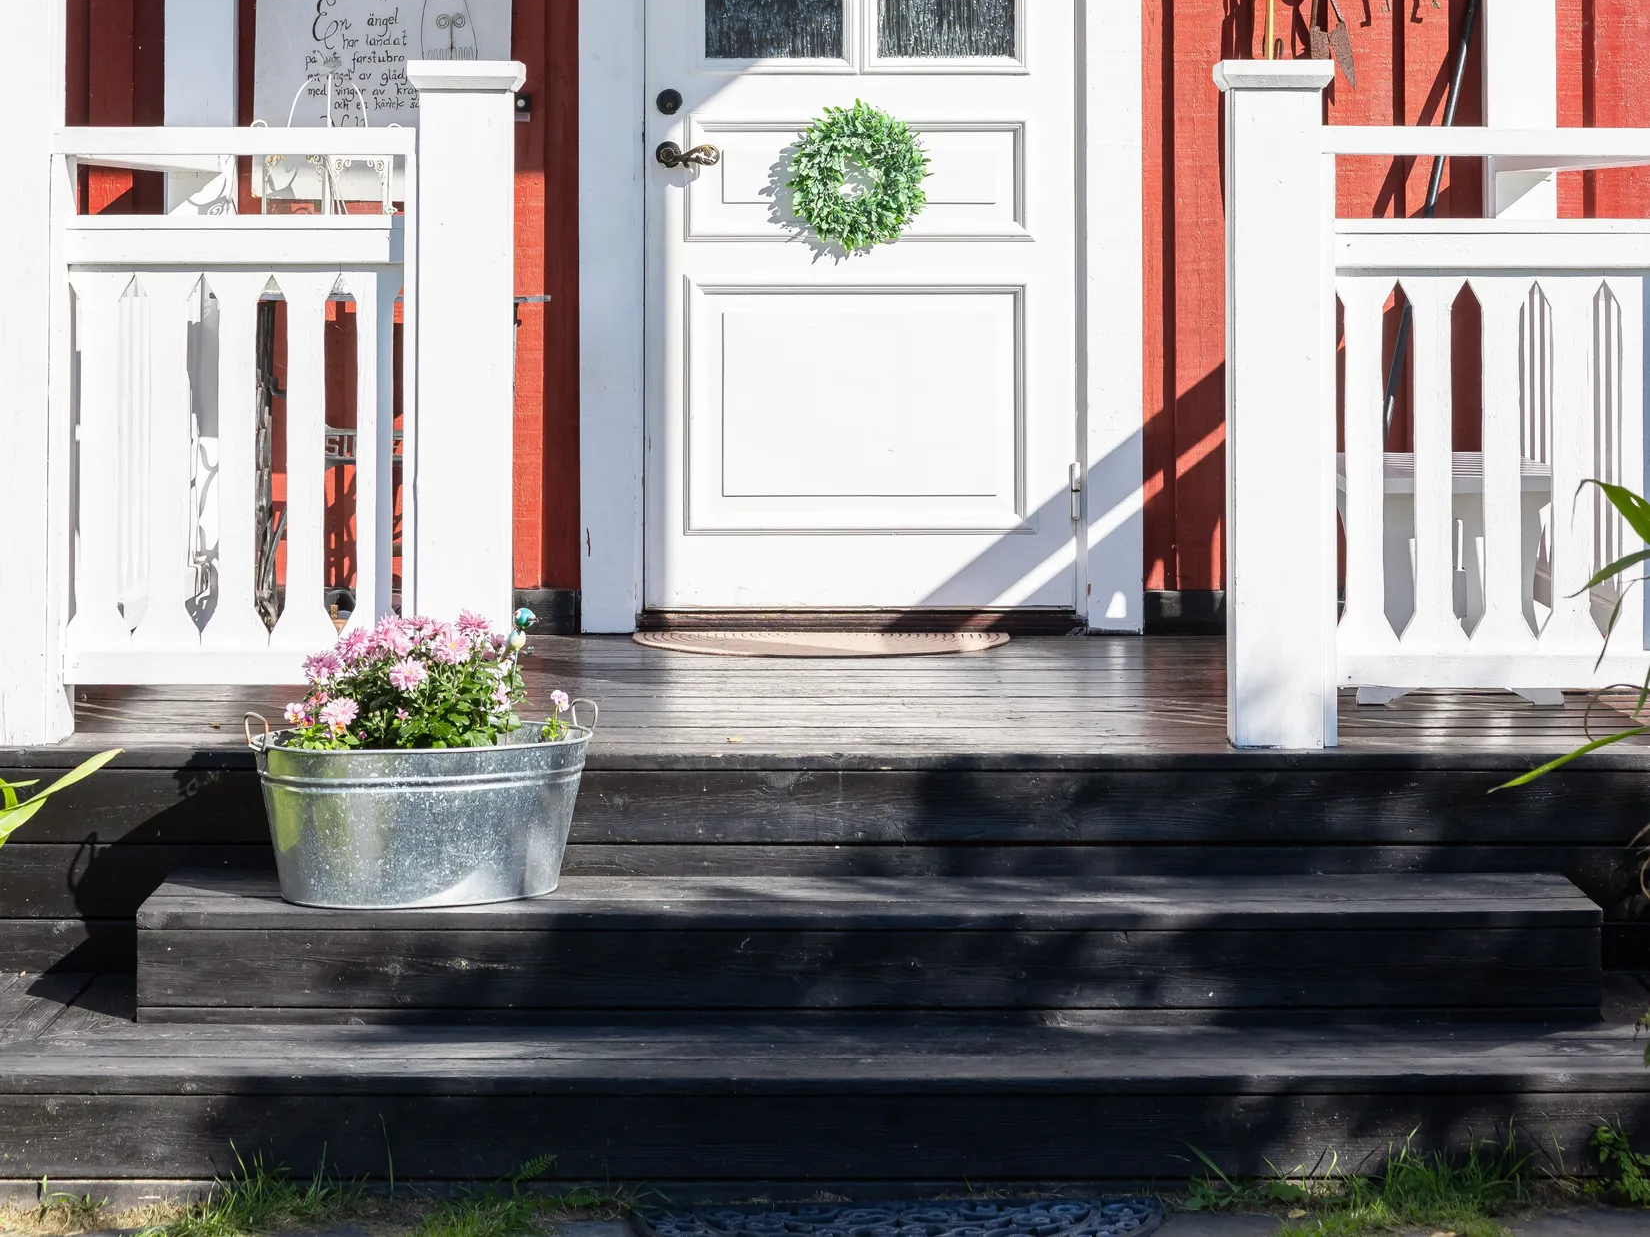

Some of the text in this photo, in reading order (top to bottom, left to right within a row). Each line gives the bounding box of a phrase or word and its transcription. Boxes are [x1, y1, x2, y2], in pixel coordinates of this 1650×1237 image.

[367, 6, 399, 37] ängel
[342, 29, 407, 50] har landat
[305, 49, 318, 71] på
[352, 50, 405, 73] farstubro
[359, 72, 372, 81] av
[307, 83, 327, 97] med
[372, 88, 385, 96] av
[334, 98, 349, 110] och
[373, 96, 404, 111] kärlek
